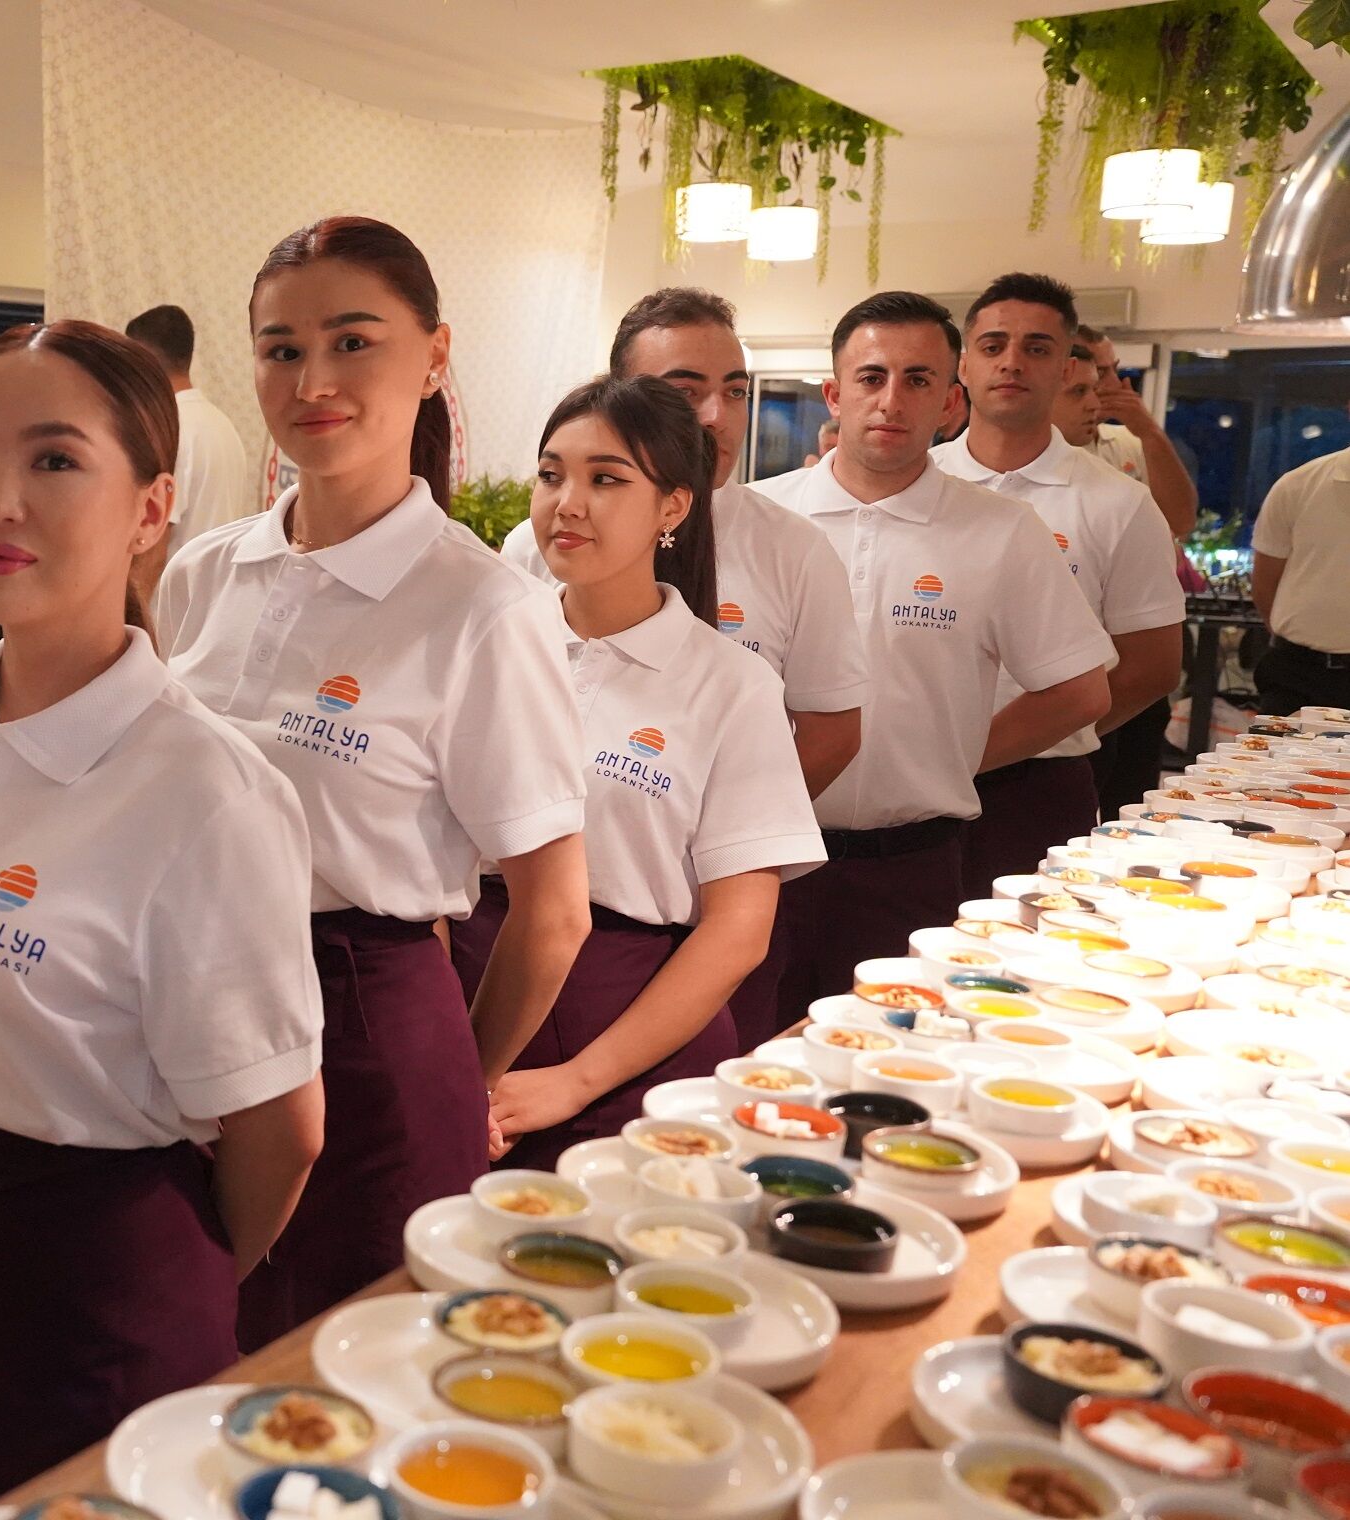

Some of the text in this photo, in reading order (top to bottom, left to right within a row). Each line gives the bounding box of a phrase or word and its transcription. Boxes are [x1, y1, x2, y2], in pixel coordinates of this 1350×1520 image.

[892, 604, 957, 622] ANTALYA
[895, 620, 952, 630] LOKANTASI
[279, 711, 369, 753] ANTALYA
[276, 733, 358, 764] LOKANTASI
[595, 751, 672, 792] ANTALYA
[596, 768, 662, 799] LOKANTASI
